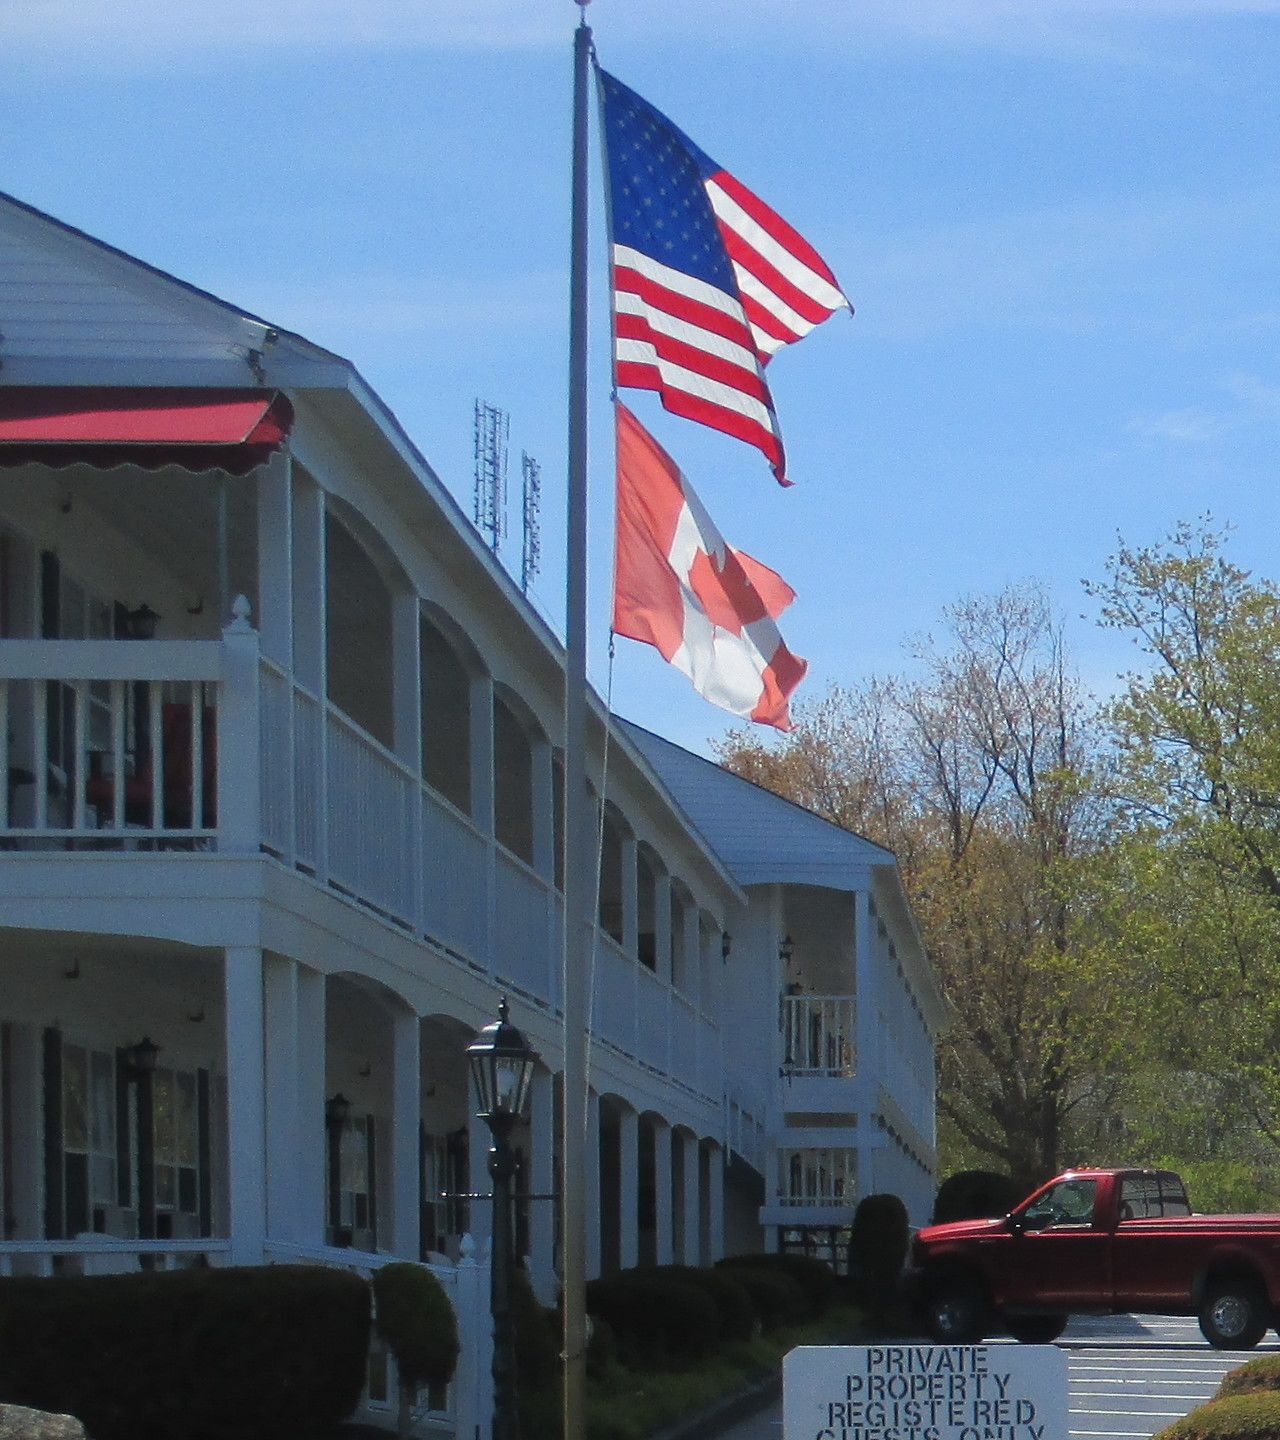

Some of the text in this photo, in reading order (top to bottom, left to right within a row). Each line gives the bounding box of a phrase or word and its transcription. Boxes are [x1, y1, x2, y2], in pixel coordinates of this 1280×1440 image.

[867, 1347, 988, 1373] PRIVATE
[846, 1373, 1011, 1400] PROPERTY
[828, 1400, 1036, 1428] REGISTERED
